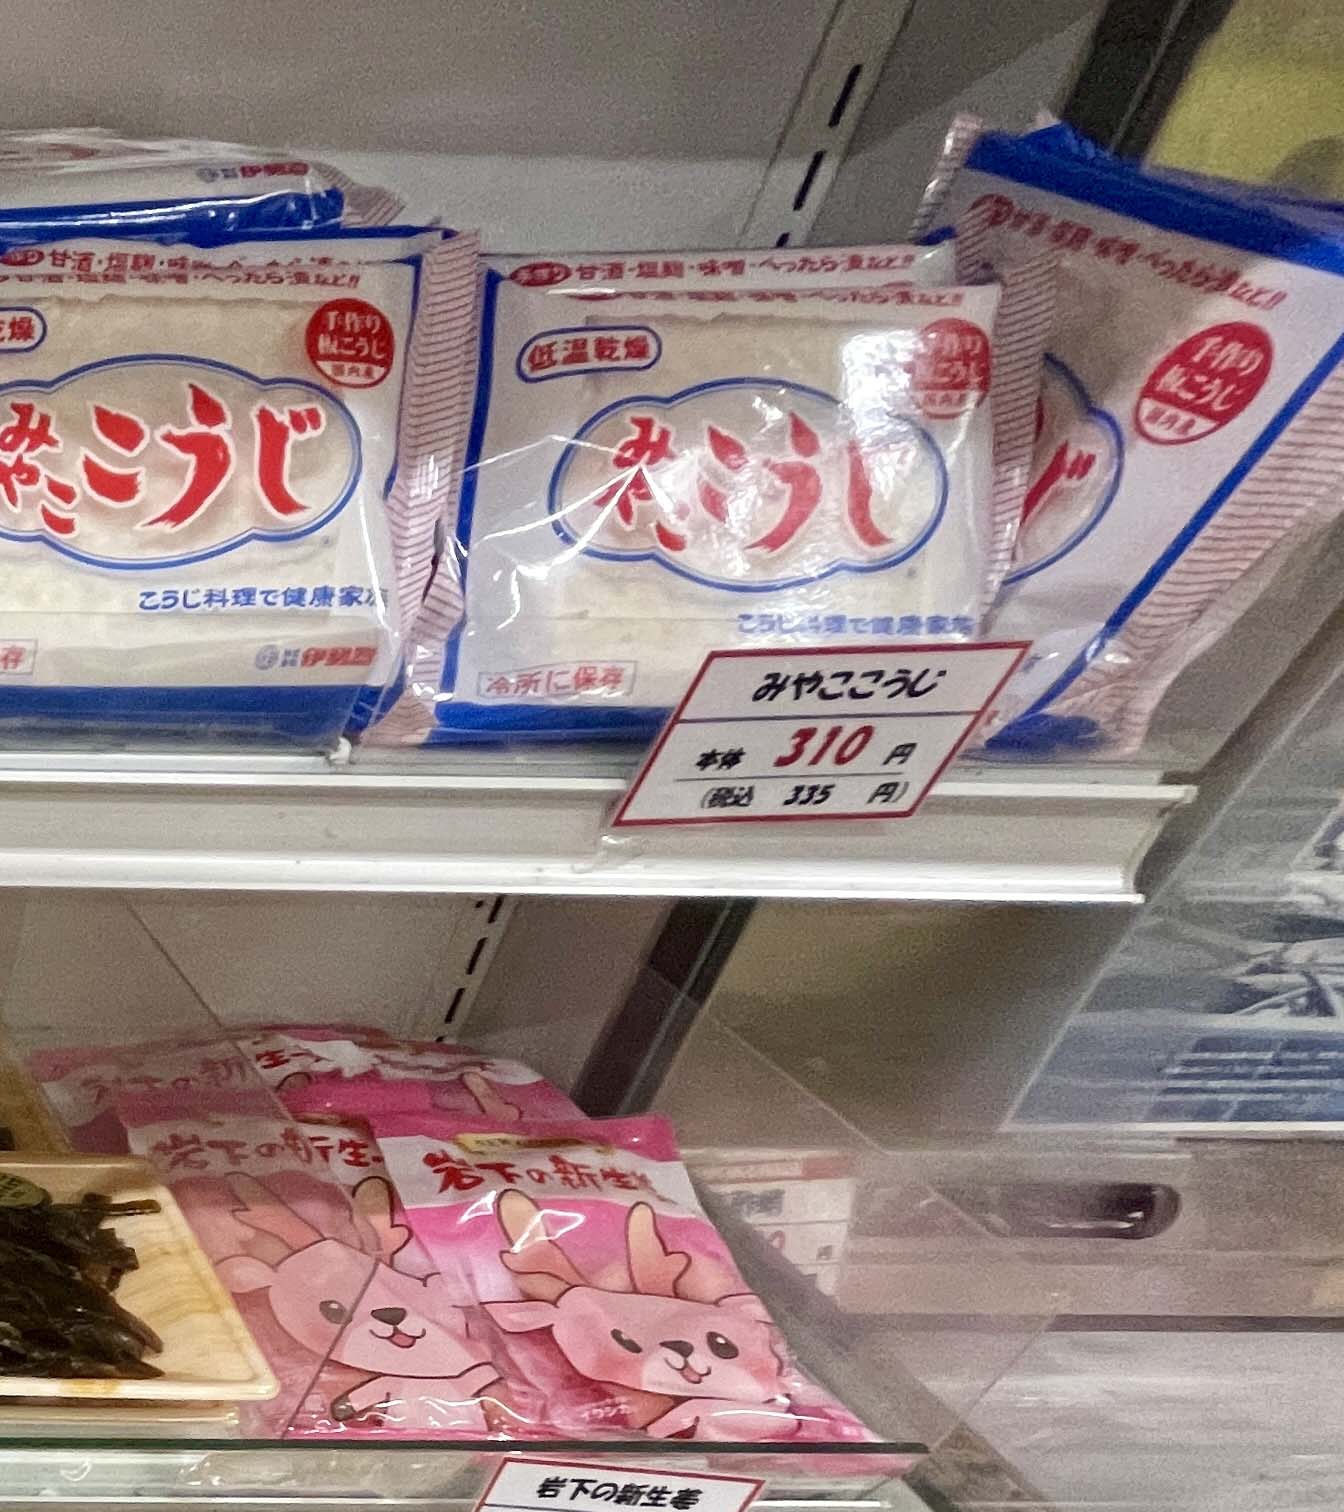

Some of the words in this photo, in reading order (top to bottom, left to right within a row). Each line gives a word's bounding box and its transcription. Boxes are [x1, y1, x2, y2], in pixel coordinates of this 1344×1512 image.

[752, 668, 948, 702] みやここうじ
[694, 748, 745, 771] 本体
[773, 724, 875, 769] 310
[882, 742, 918, 767] 円
[700, 785, 756, 809] (税込
[782, 783, 833, 806] 335
[866, 781, 910, 805] 円)
[535, 1475, 705, 1511] 岩下の新生姜
